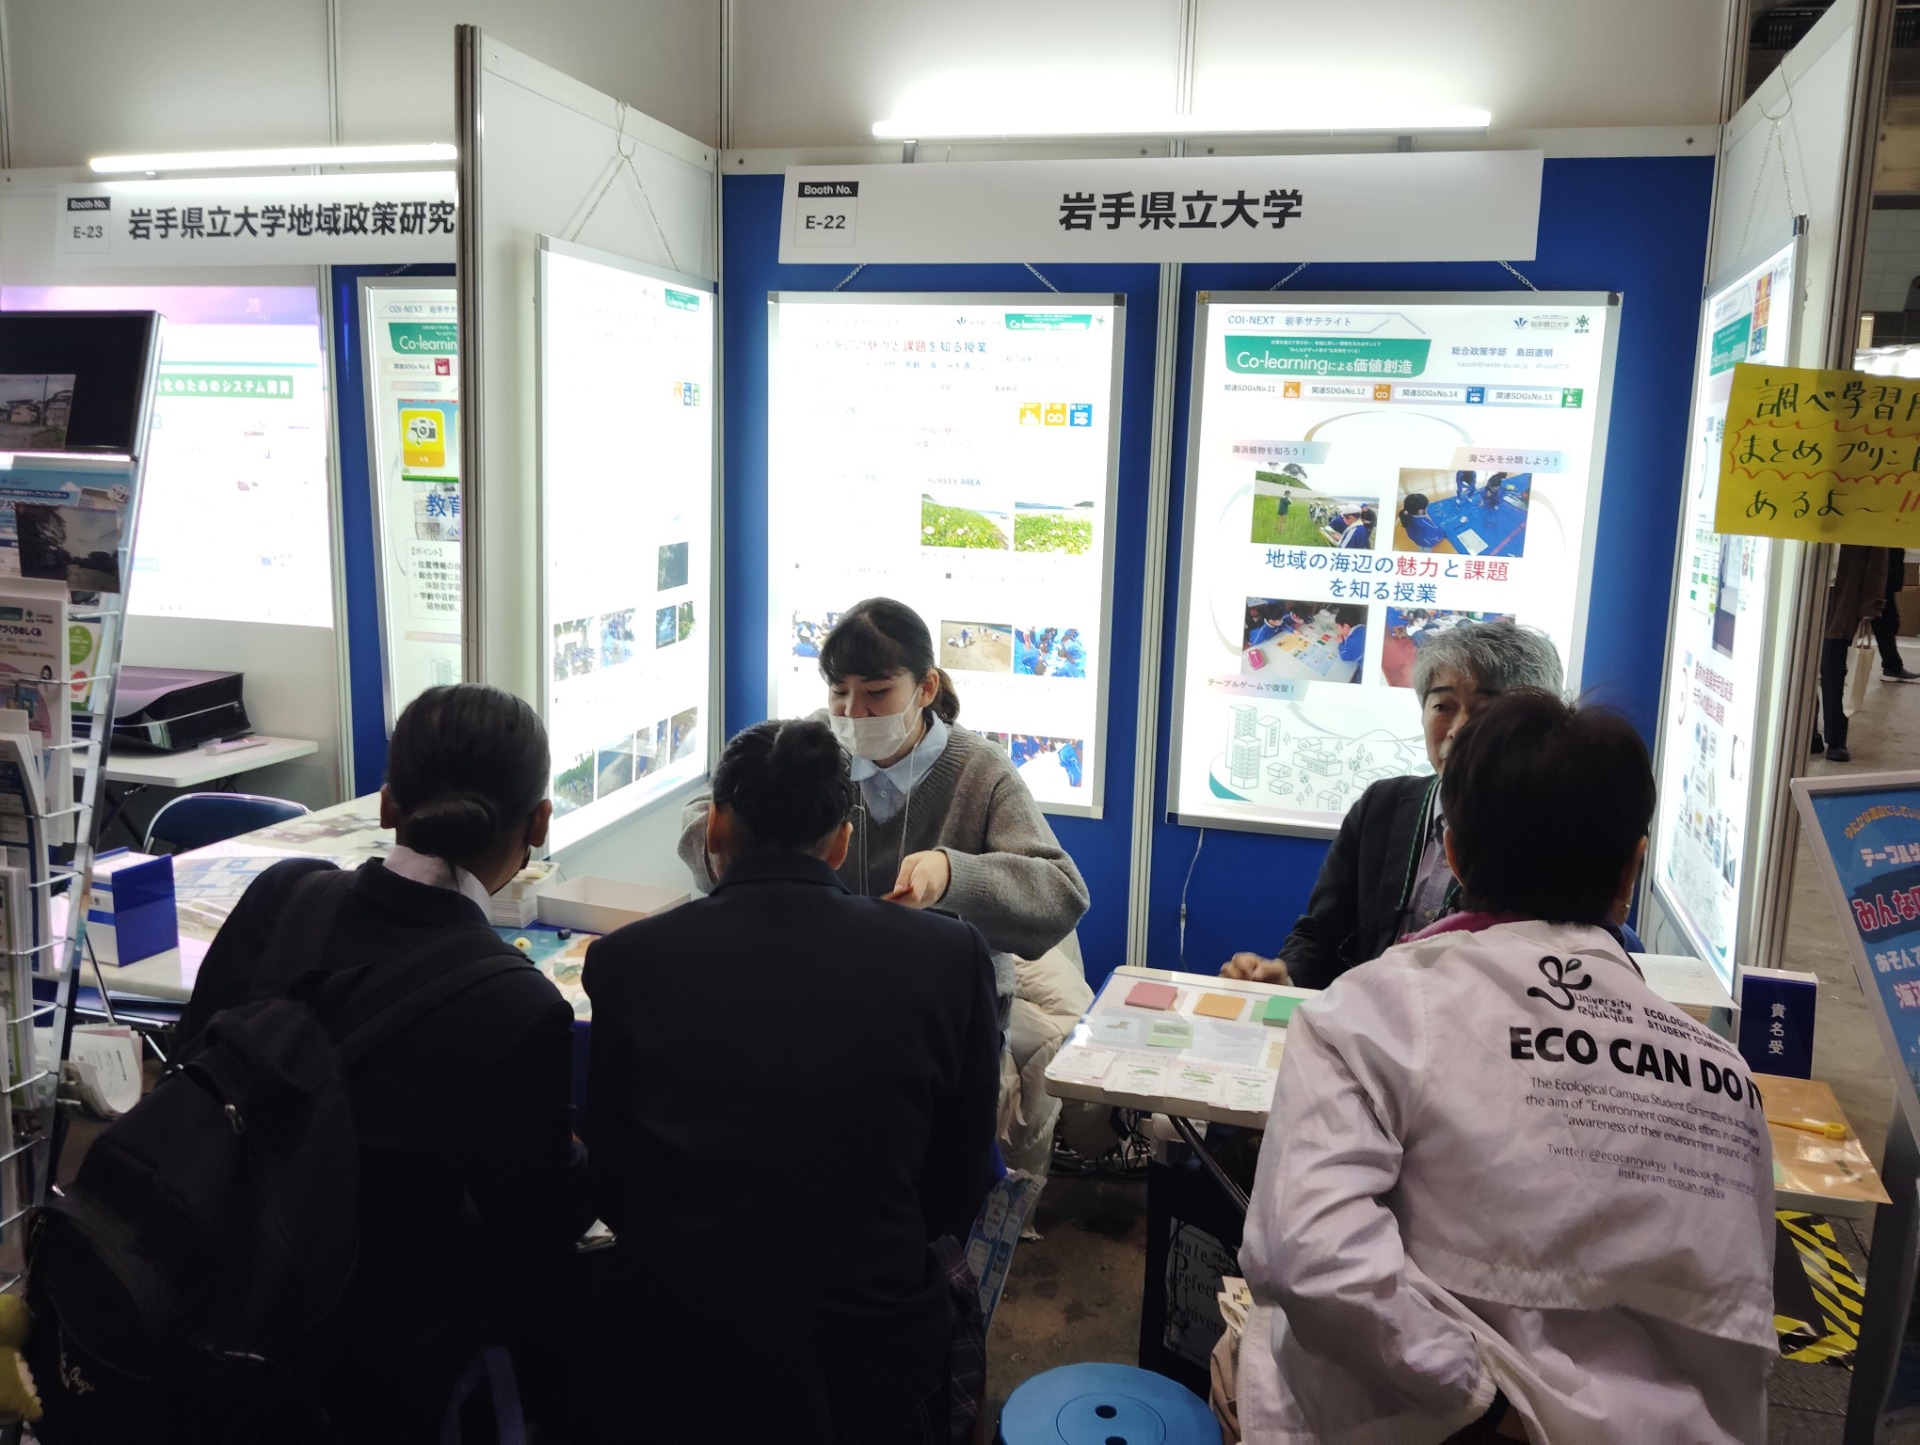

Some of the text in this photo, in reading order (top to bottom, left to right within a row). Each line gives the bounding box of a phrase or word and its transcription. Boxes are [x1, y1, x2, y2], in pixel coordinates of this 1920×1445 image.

[803, 184, 852, 195] Booth No.
[1058, 188, 1304, 232] 岩手県立大学
[128, 200, 456, 241] 岩手県立大学地域政策研究
[805, 214, 846, 230] E-22
[73, 225, 103, 239] E-23
[1227, 315, 1352, 327] COI-NEXT 岩手サテライト
[1451, 346, 1508, 357] 総合政策学部
[1265, 548, 1510, 582] 地域の海辺の魅力と課題
[1329, 578, 1438, 604] を知る授業
[1574, 992, 1632, 1011] University
[1577, 1005, 1634, 1024] Ryukyus
[1643, 1006, 1701, 1036] ECOLOGICAL
[1647, 1019, 1692, 1041] STUDENT
[1768, 1002, 1787, 1056] 貴名受
[1509, 1026, 1599, 1066] ECO
[1609, 1037, 1693, 1088] CAN
[1699, 1056, 1744, 1103] DO
[1525, 1094, 1545, 1107] the
[1547, 1097, 1569, 1109] aim
[1571, 1098, 1584, 1110] of
[1530, 1076, 1553, 1089] The
[1555, 1078, 1608, 1096] Ecological
[1608, 1086, 1650, 1104] Campus
[1651, 1093, 1685, 1112] Student
[1627, 1123, 1639, 1135] of
